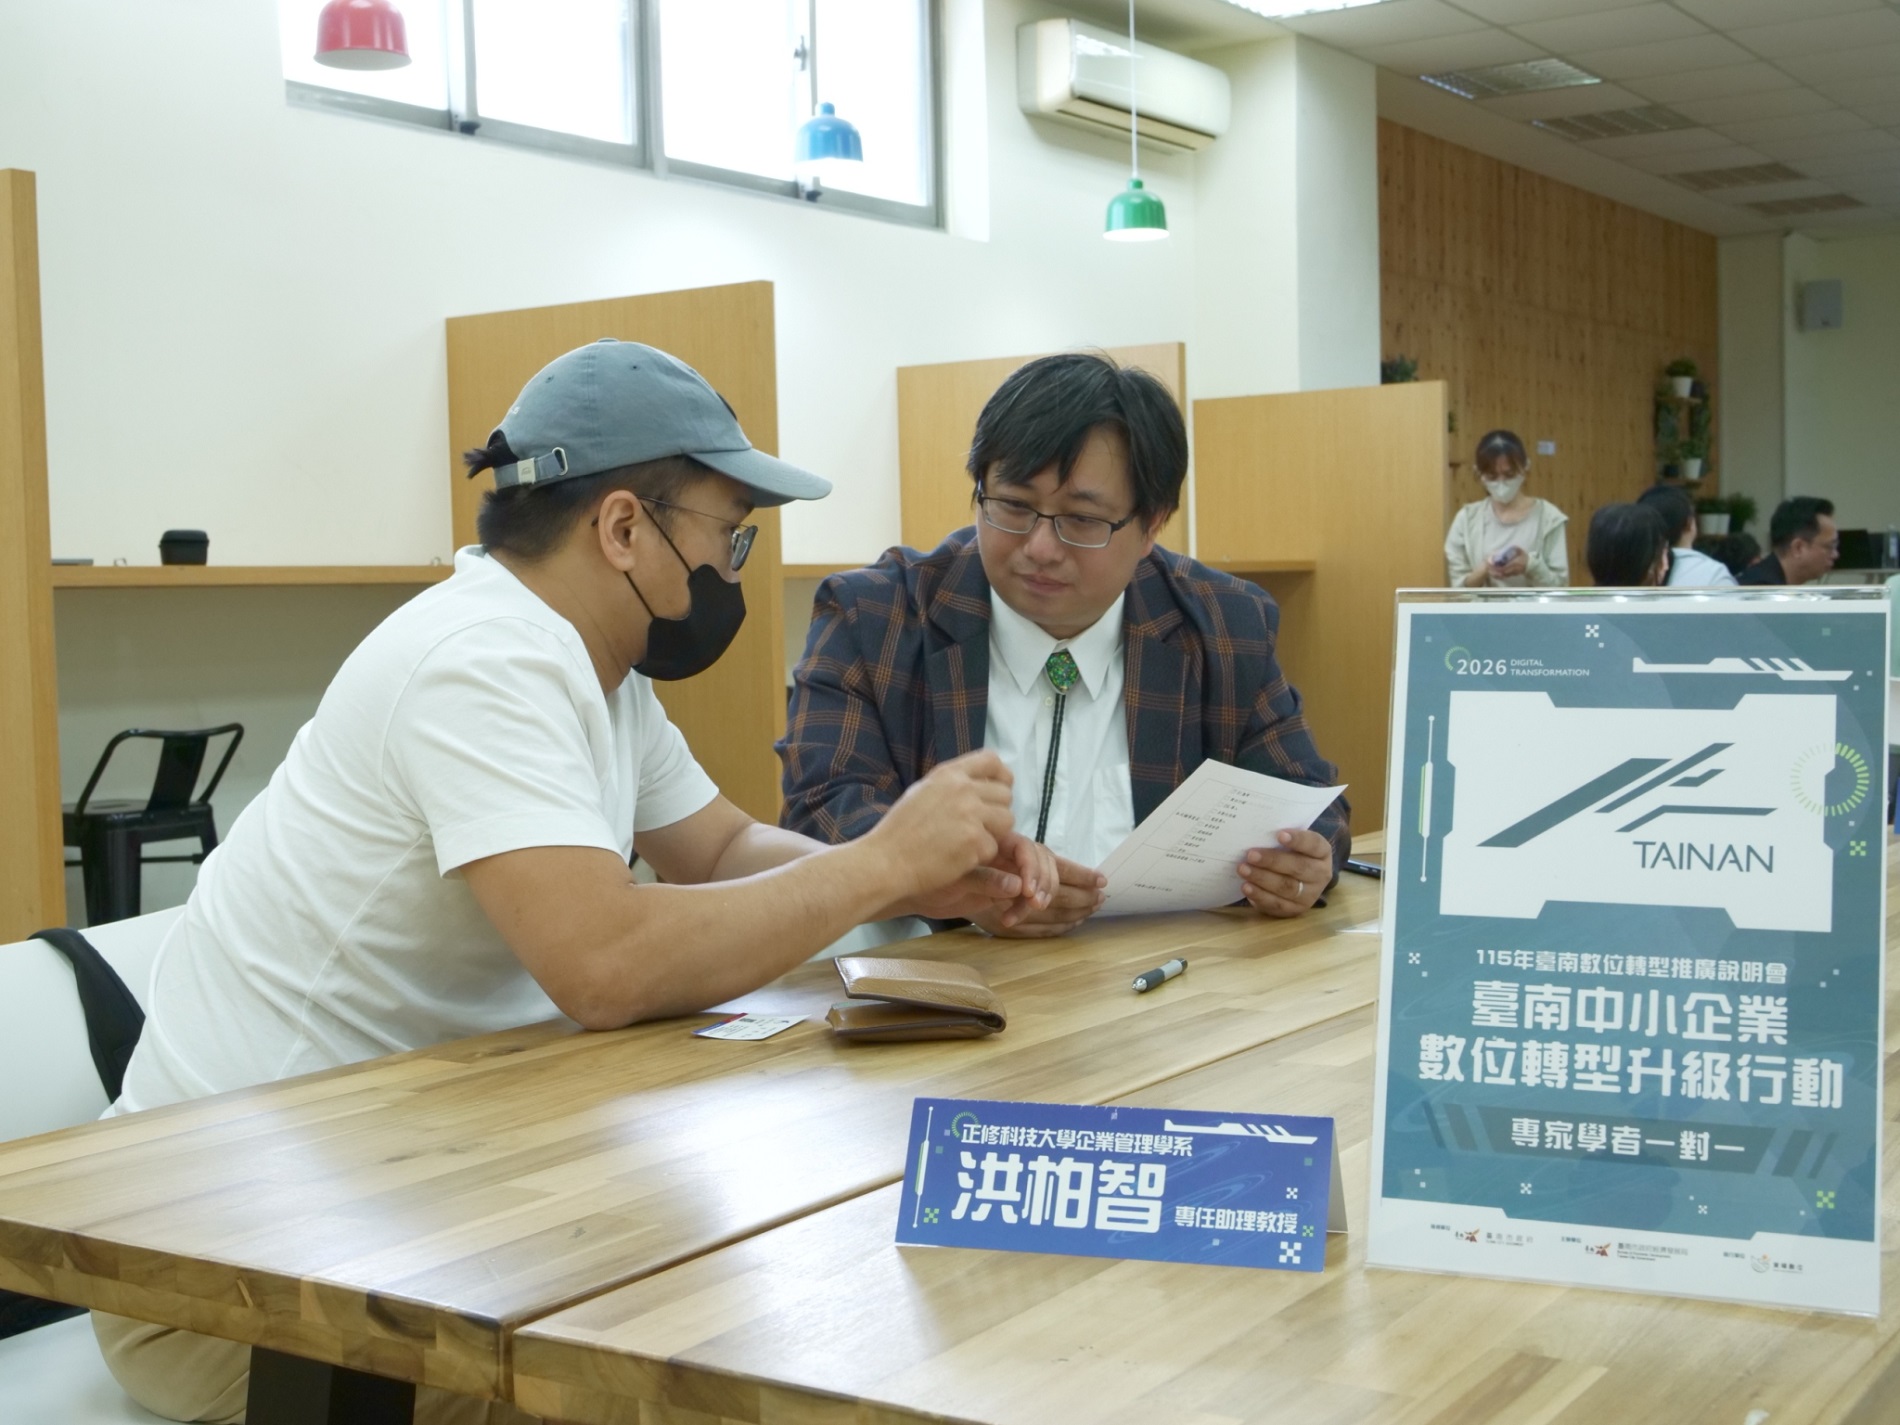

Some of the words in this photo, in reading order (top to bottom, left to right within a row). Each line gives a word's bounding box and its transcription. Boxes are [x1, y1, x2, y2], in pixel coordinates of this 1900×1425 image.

[1456, 659, 1507, 675] 2026
[1510, 659, 1544, 667] DIGITAL
[1510, 668, 1590, 677] TRANSFORMATION
[1633, 841, 1774, 874] TAINAN
[1476, 949, 1788, 985] 115年臺南數位轉型推廣說明會
[1471, 980, 1789, 1045] 臺南中小企業
[1418, 1033, 1844, 1109] 數位轉型升級行動
[960, 1123, 1194, 1157] 正修科技大學企業管理學系
[1510, 1117, 1745, 1161] 專家學者一對一
[951, 1151, 1167, 1233] 洪柏智
[1174, 1205, 1298, 1235] 專任助理教授
